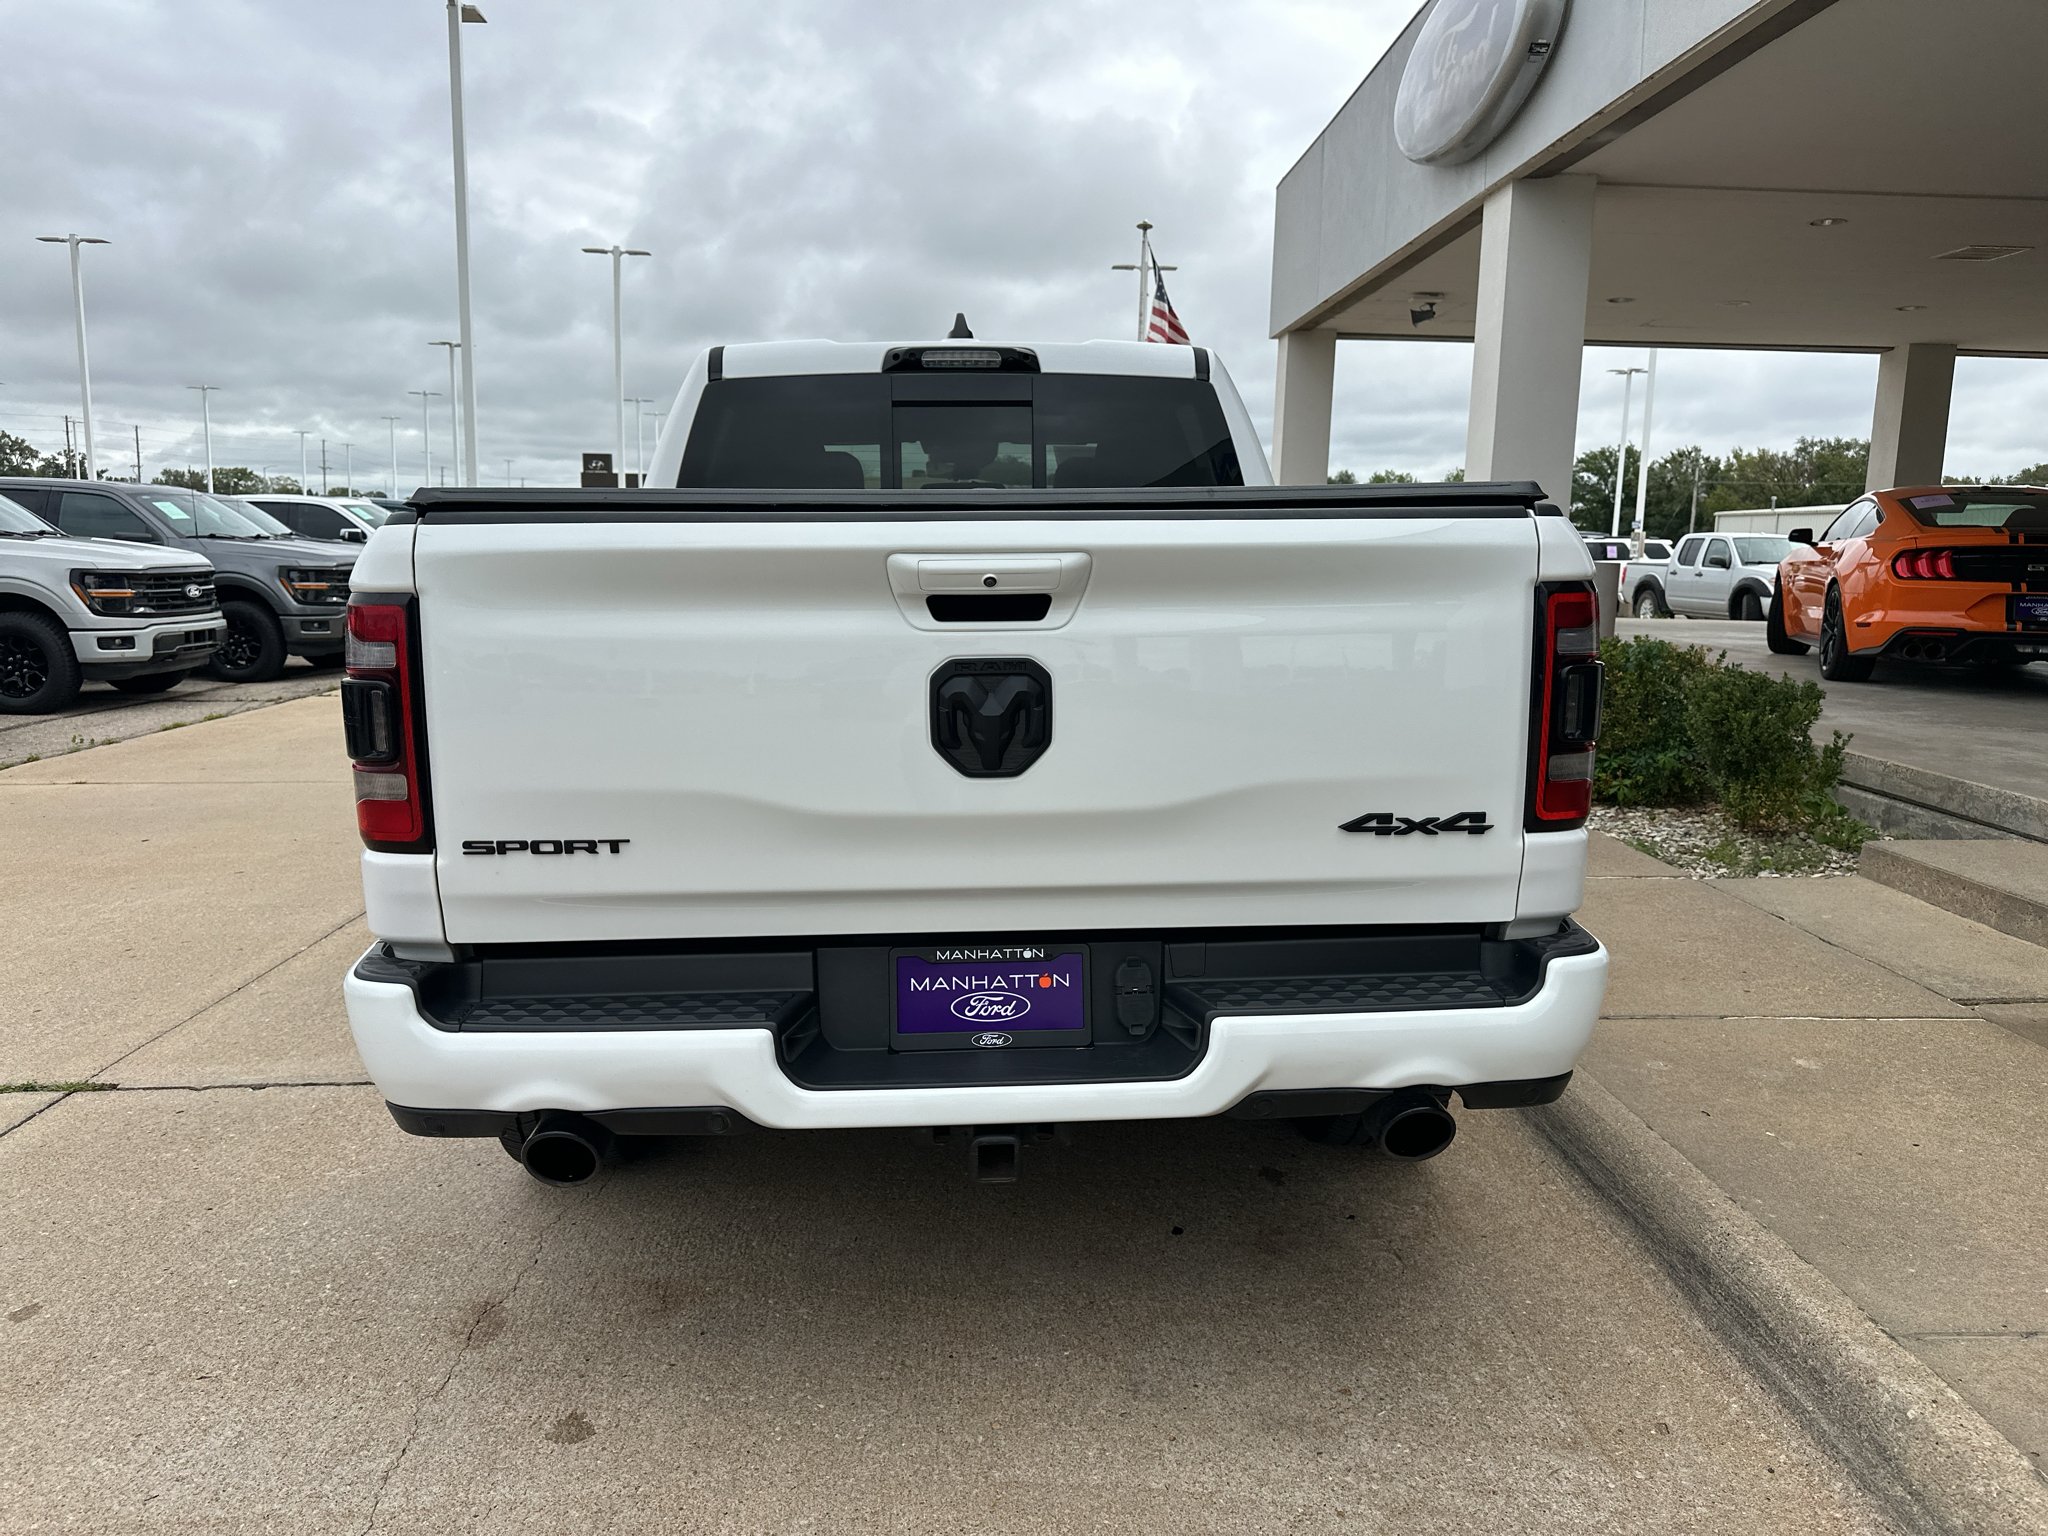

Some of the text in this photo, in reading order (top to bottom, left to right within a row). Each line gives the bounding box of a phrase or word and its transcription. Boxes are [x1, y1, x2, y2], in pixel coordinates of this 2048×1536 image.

[1337, 811, 1495, 836] 4x4
[462, 838, 631, 855] SPORT
[964, 995, 1017, 1017] Ford
[979, 1034, 1005, 1045] Ford
